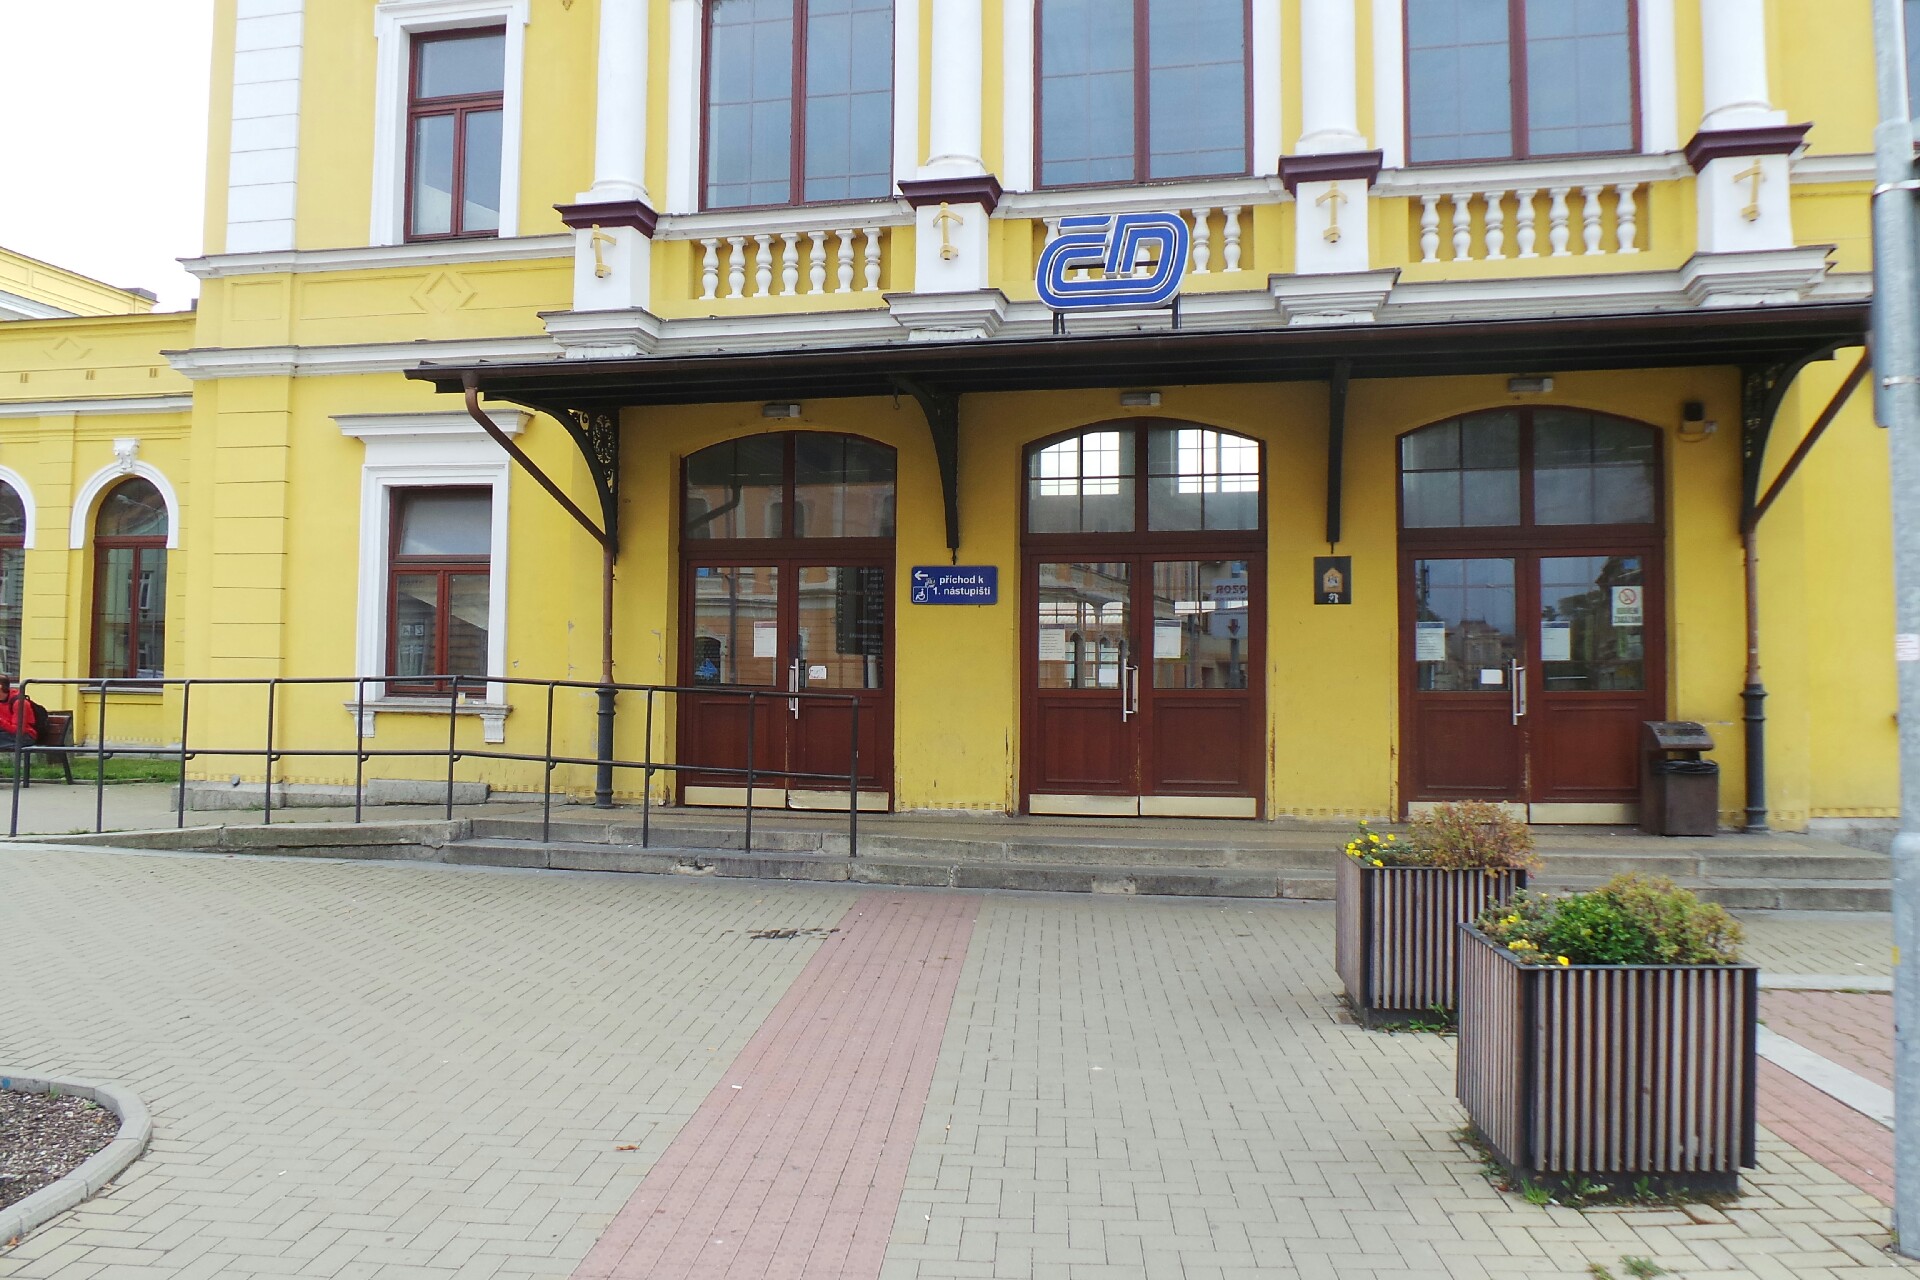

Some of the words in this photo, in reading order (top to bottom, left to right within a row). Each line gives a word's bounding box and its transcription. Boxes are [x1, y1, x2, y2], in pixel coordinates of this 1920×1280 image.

[939, 575, 976, 586] příchod
[978, 575, 984, 584] k
[933, 587, 941, 595] 1.
[943, 586, 991, 597] nástupišti
